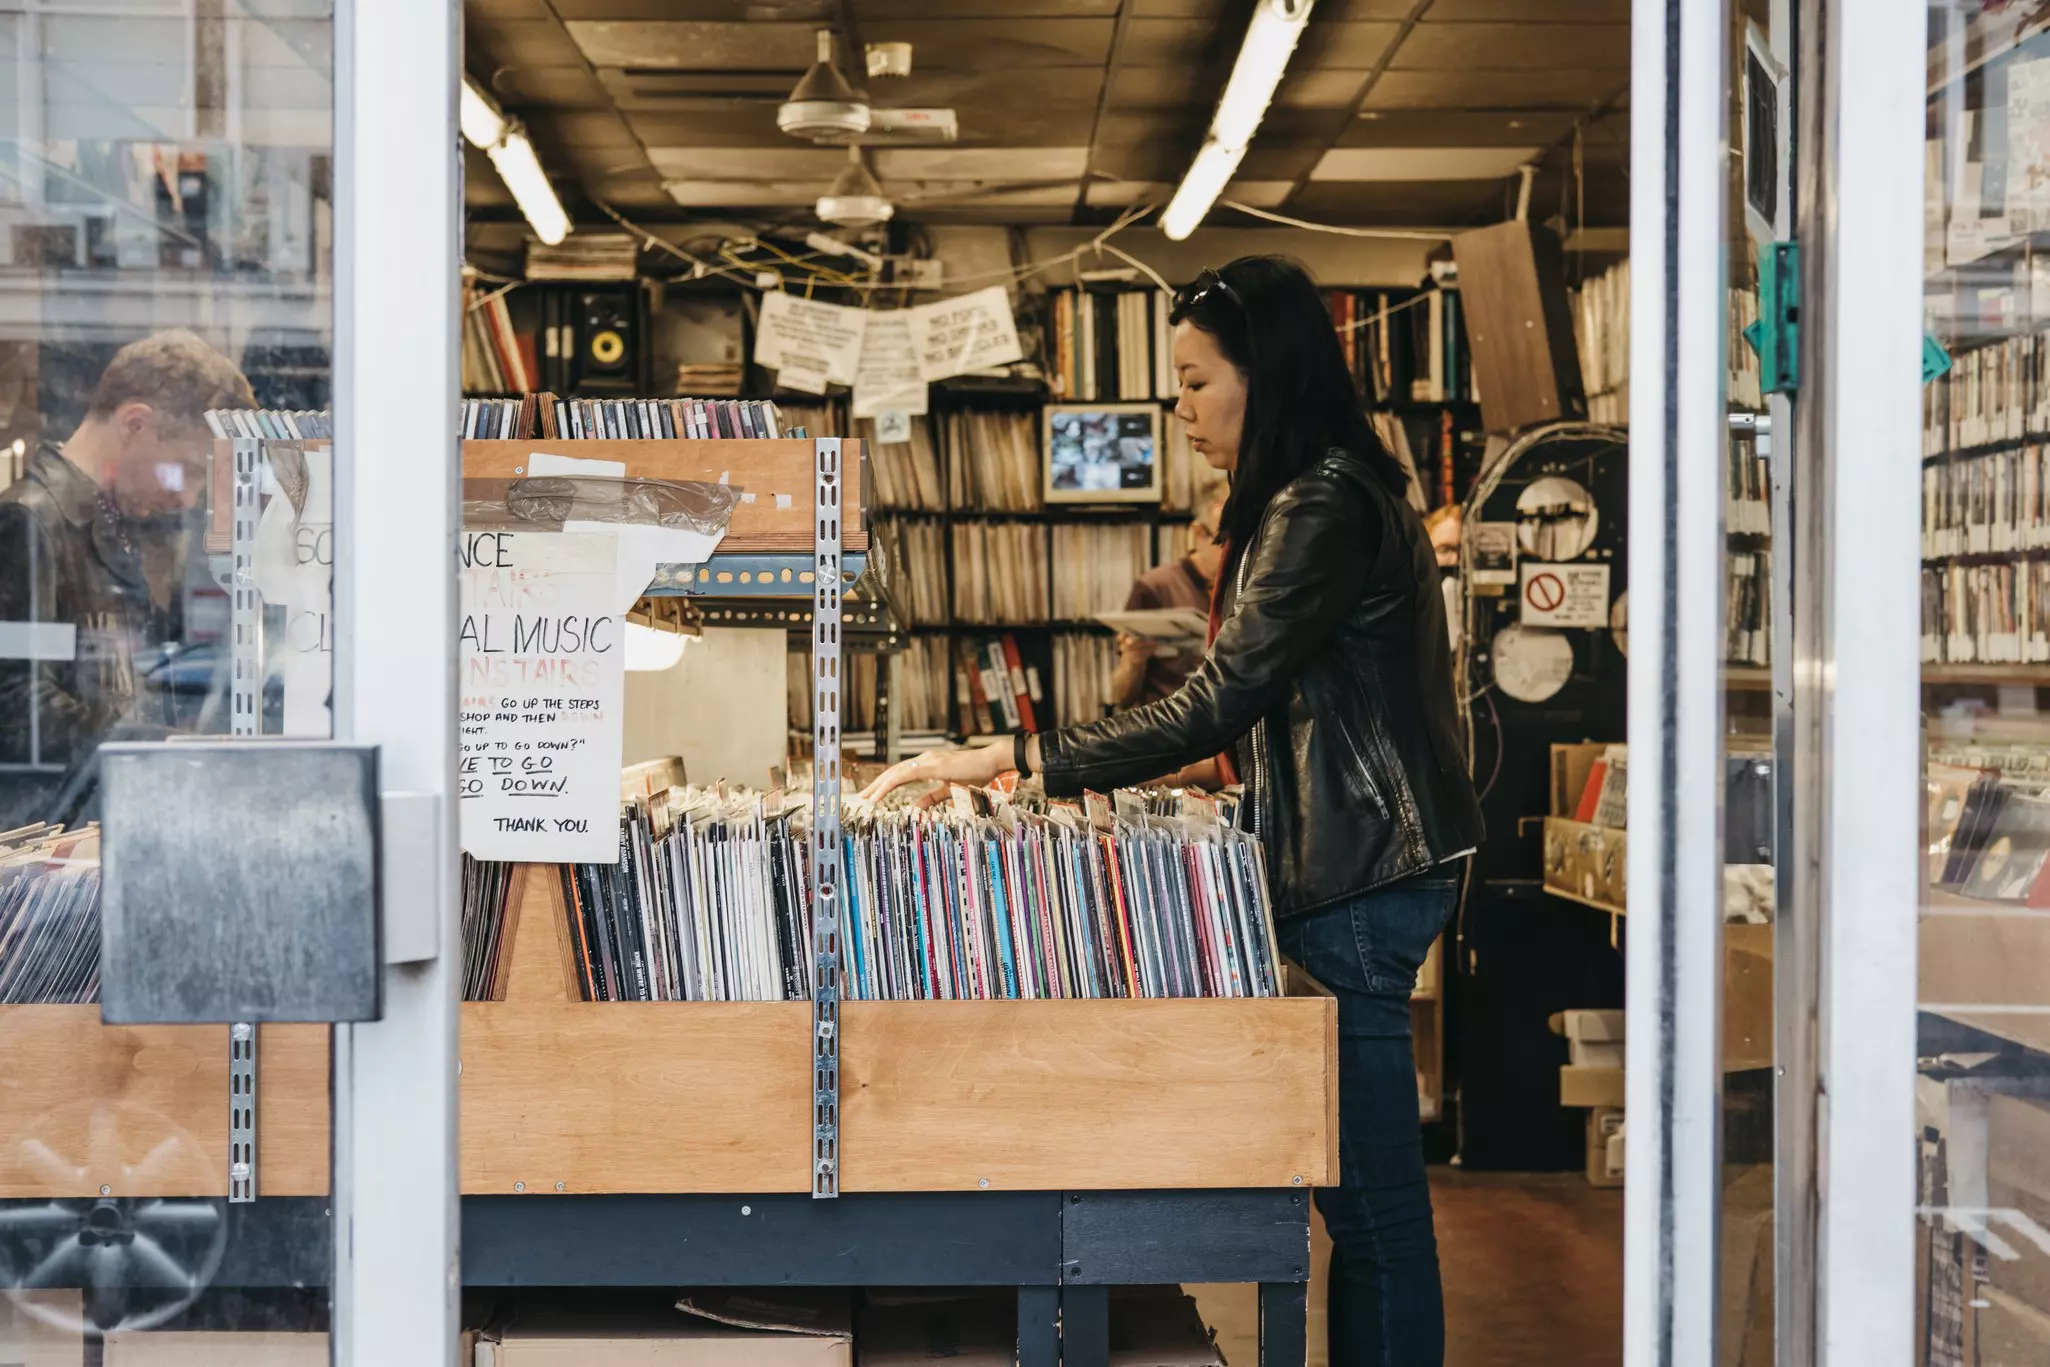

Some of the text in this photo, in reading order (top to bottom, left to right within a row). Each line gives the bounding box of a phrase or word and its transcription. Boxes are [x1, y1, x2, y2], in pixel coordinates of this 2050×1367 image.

[460, 614, 505, 653] AL
[514, 614, 612, 654] MUSIC
[501, 698, 517, 709] GO
[523, 698, 538, 709] UP
[543, 698, 563, 709] THE
[568, 698, 600, 710] STEPS
[495, 713, 518, 722] AND
[522, 713, 556, 723] THEN
[475, 743, 489, 751] UP
[495, 742, 508, 750] TO
[514, 742, 530, 750] GO
[487, 757, 513, 770] TO
[521, 756, 553, 770] GO
[493, 817, 589, 833] THANK YOU.
[620, 846, 630, 873] ADAMSON
[634, 951, 643, 968] KNOW
[636, 968, 645, 987] WHERE
